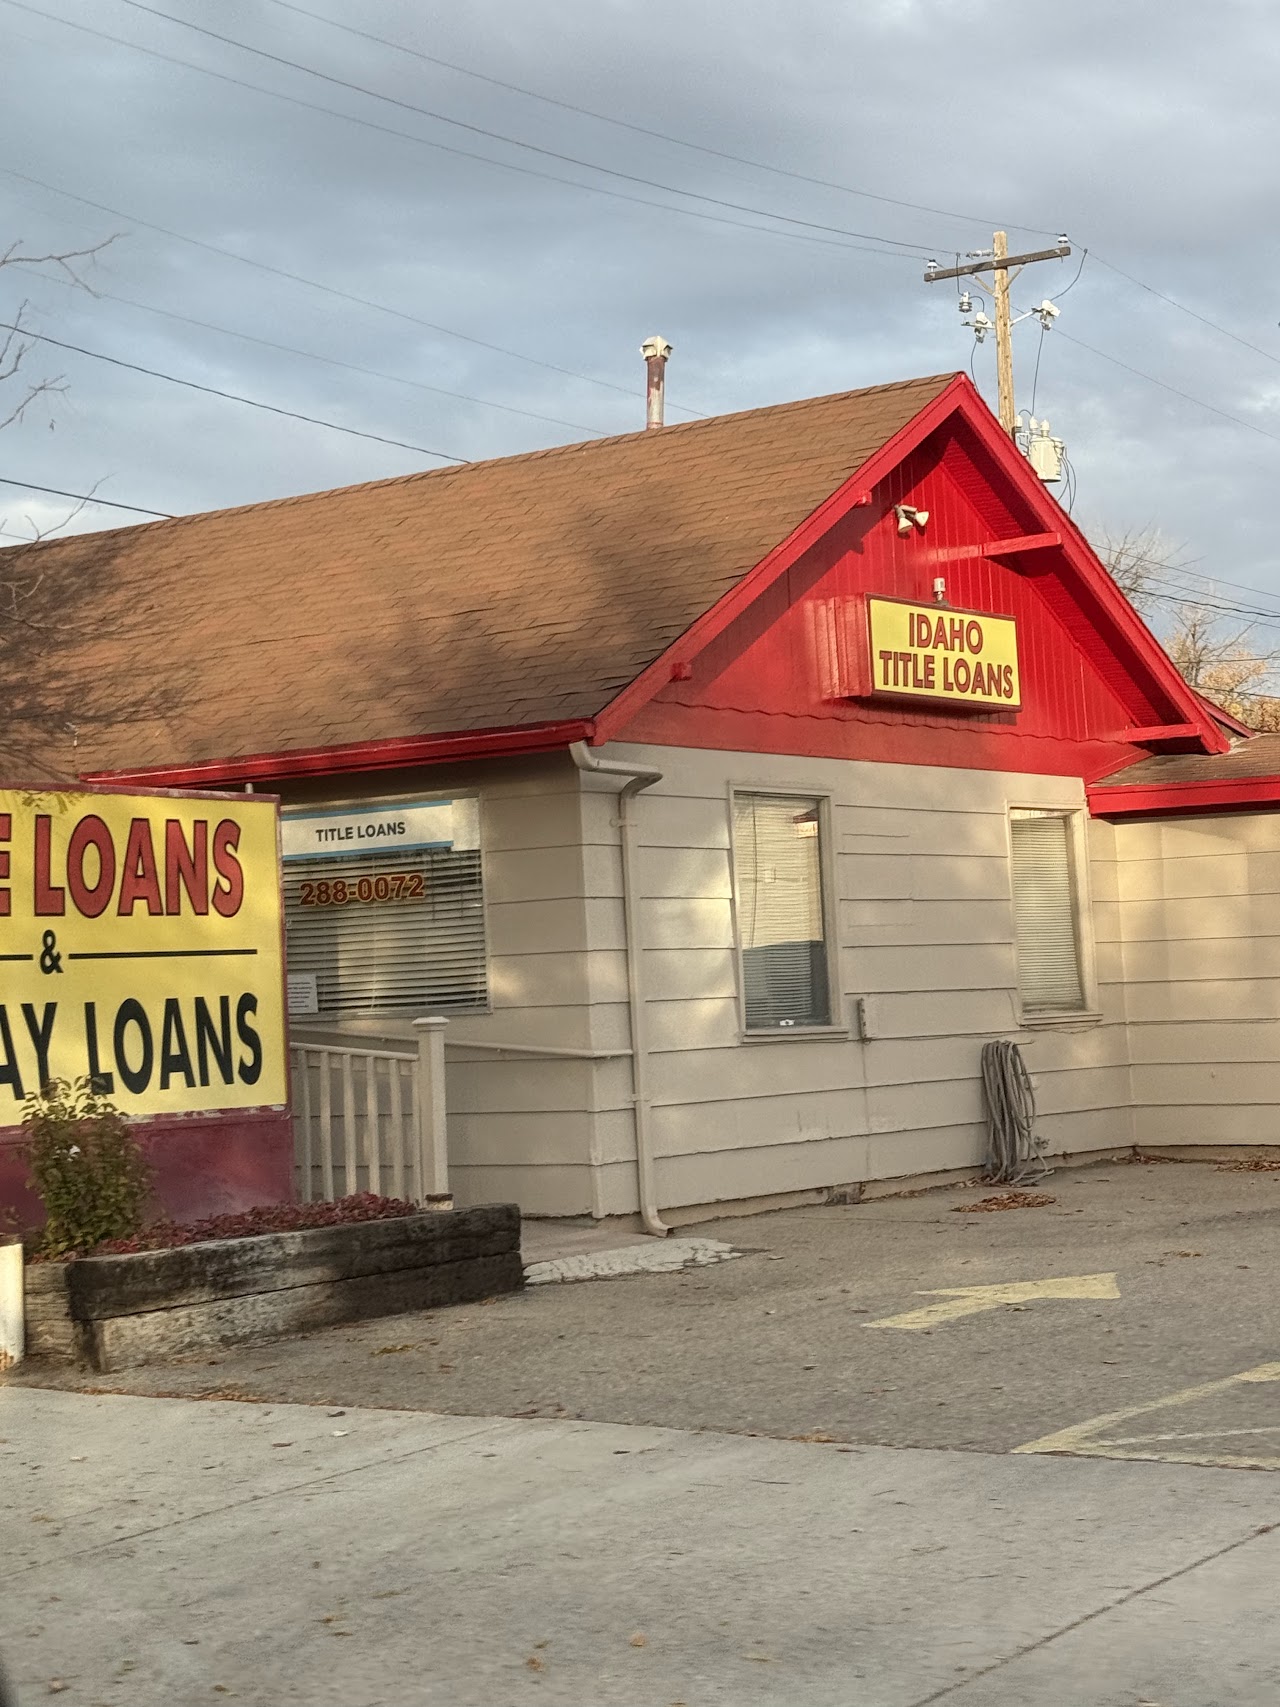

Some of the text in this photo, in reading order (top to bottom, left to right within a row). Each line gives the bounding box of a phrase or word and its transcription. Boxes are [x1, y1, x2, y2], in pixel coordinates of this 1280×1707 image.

[908, 612, 984, 655] IDAHO
[879, 650, 1014, 699] TITLE LOANS
[315, 821, 406, 842] TITLE LOANS
[34, 813, 244, 919] LOANS
[299, 873, 425, 907] 288-0072
[39, 929, 64, 975] &
[84, 992, 263, 1095] LOANS
